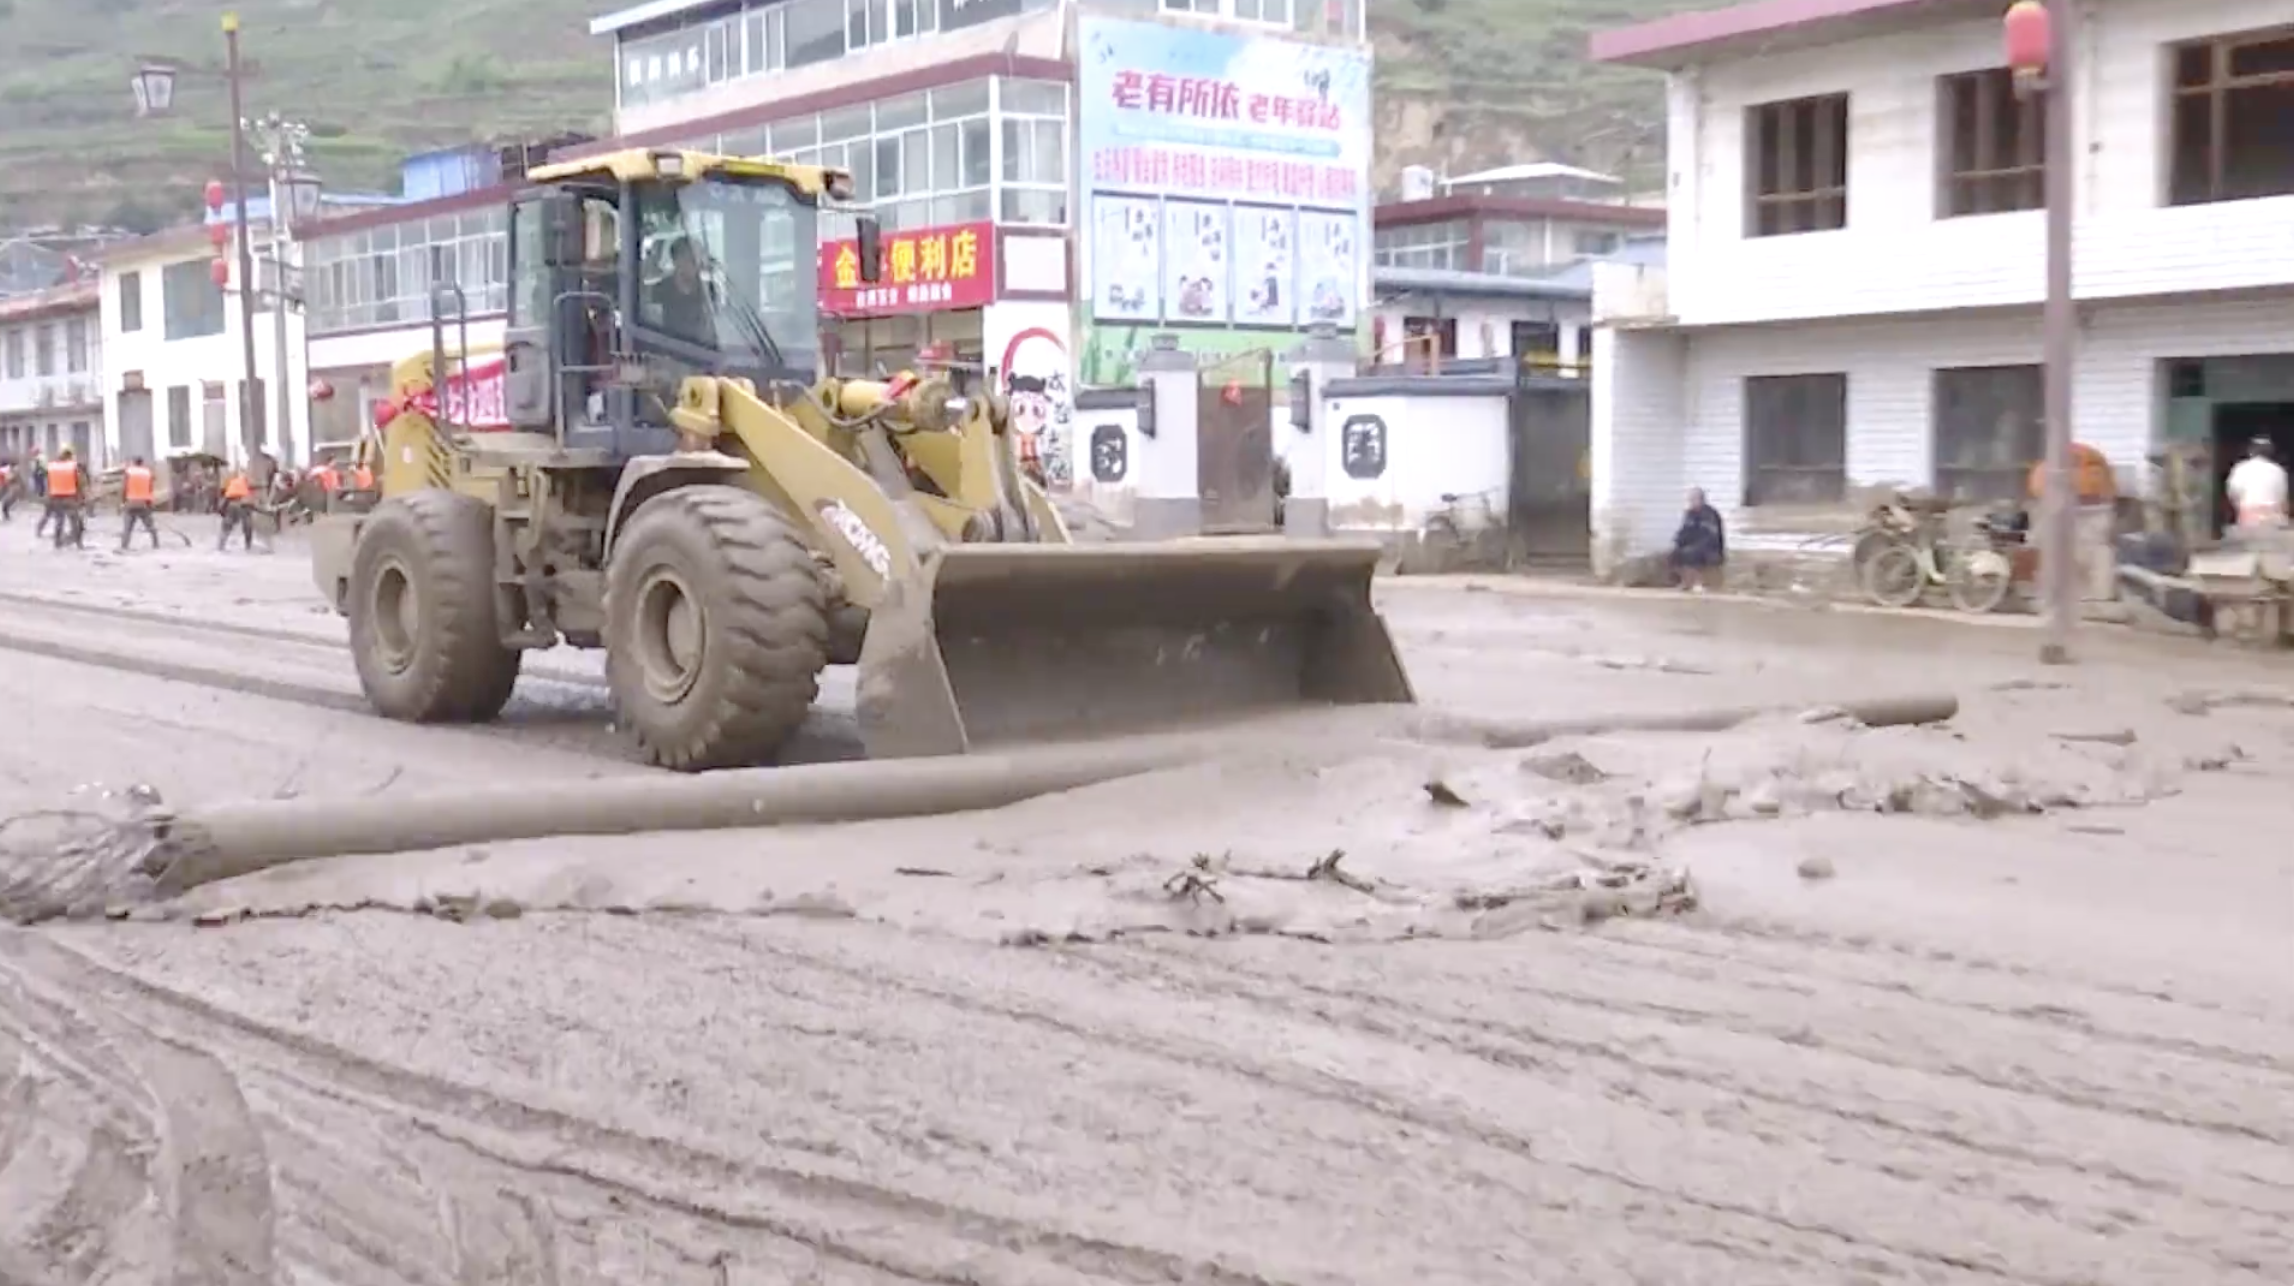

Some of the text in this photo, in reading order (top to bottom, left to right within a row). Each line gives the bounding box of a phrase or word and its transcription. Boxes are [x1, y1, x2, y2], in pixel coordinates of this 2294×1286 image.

[1111, 70, 1240, 119] 老有所依
[835, 229, 978, 289] 金便利店
